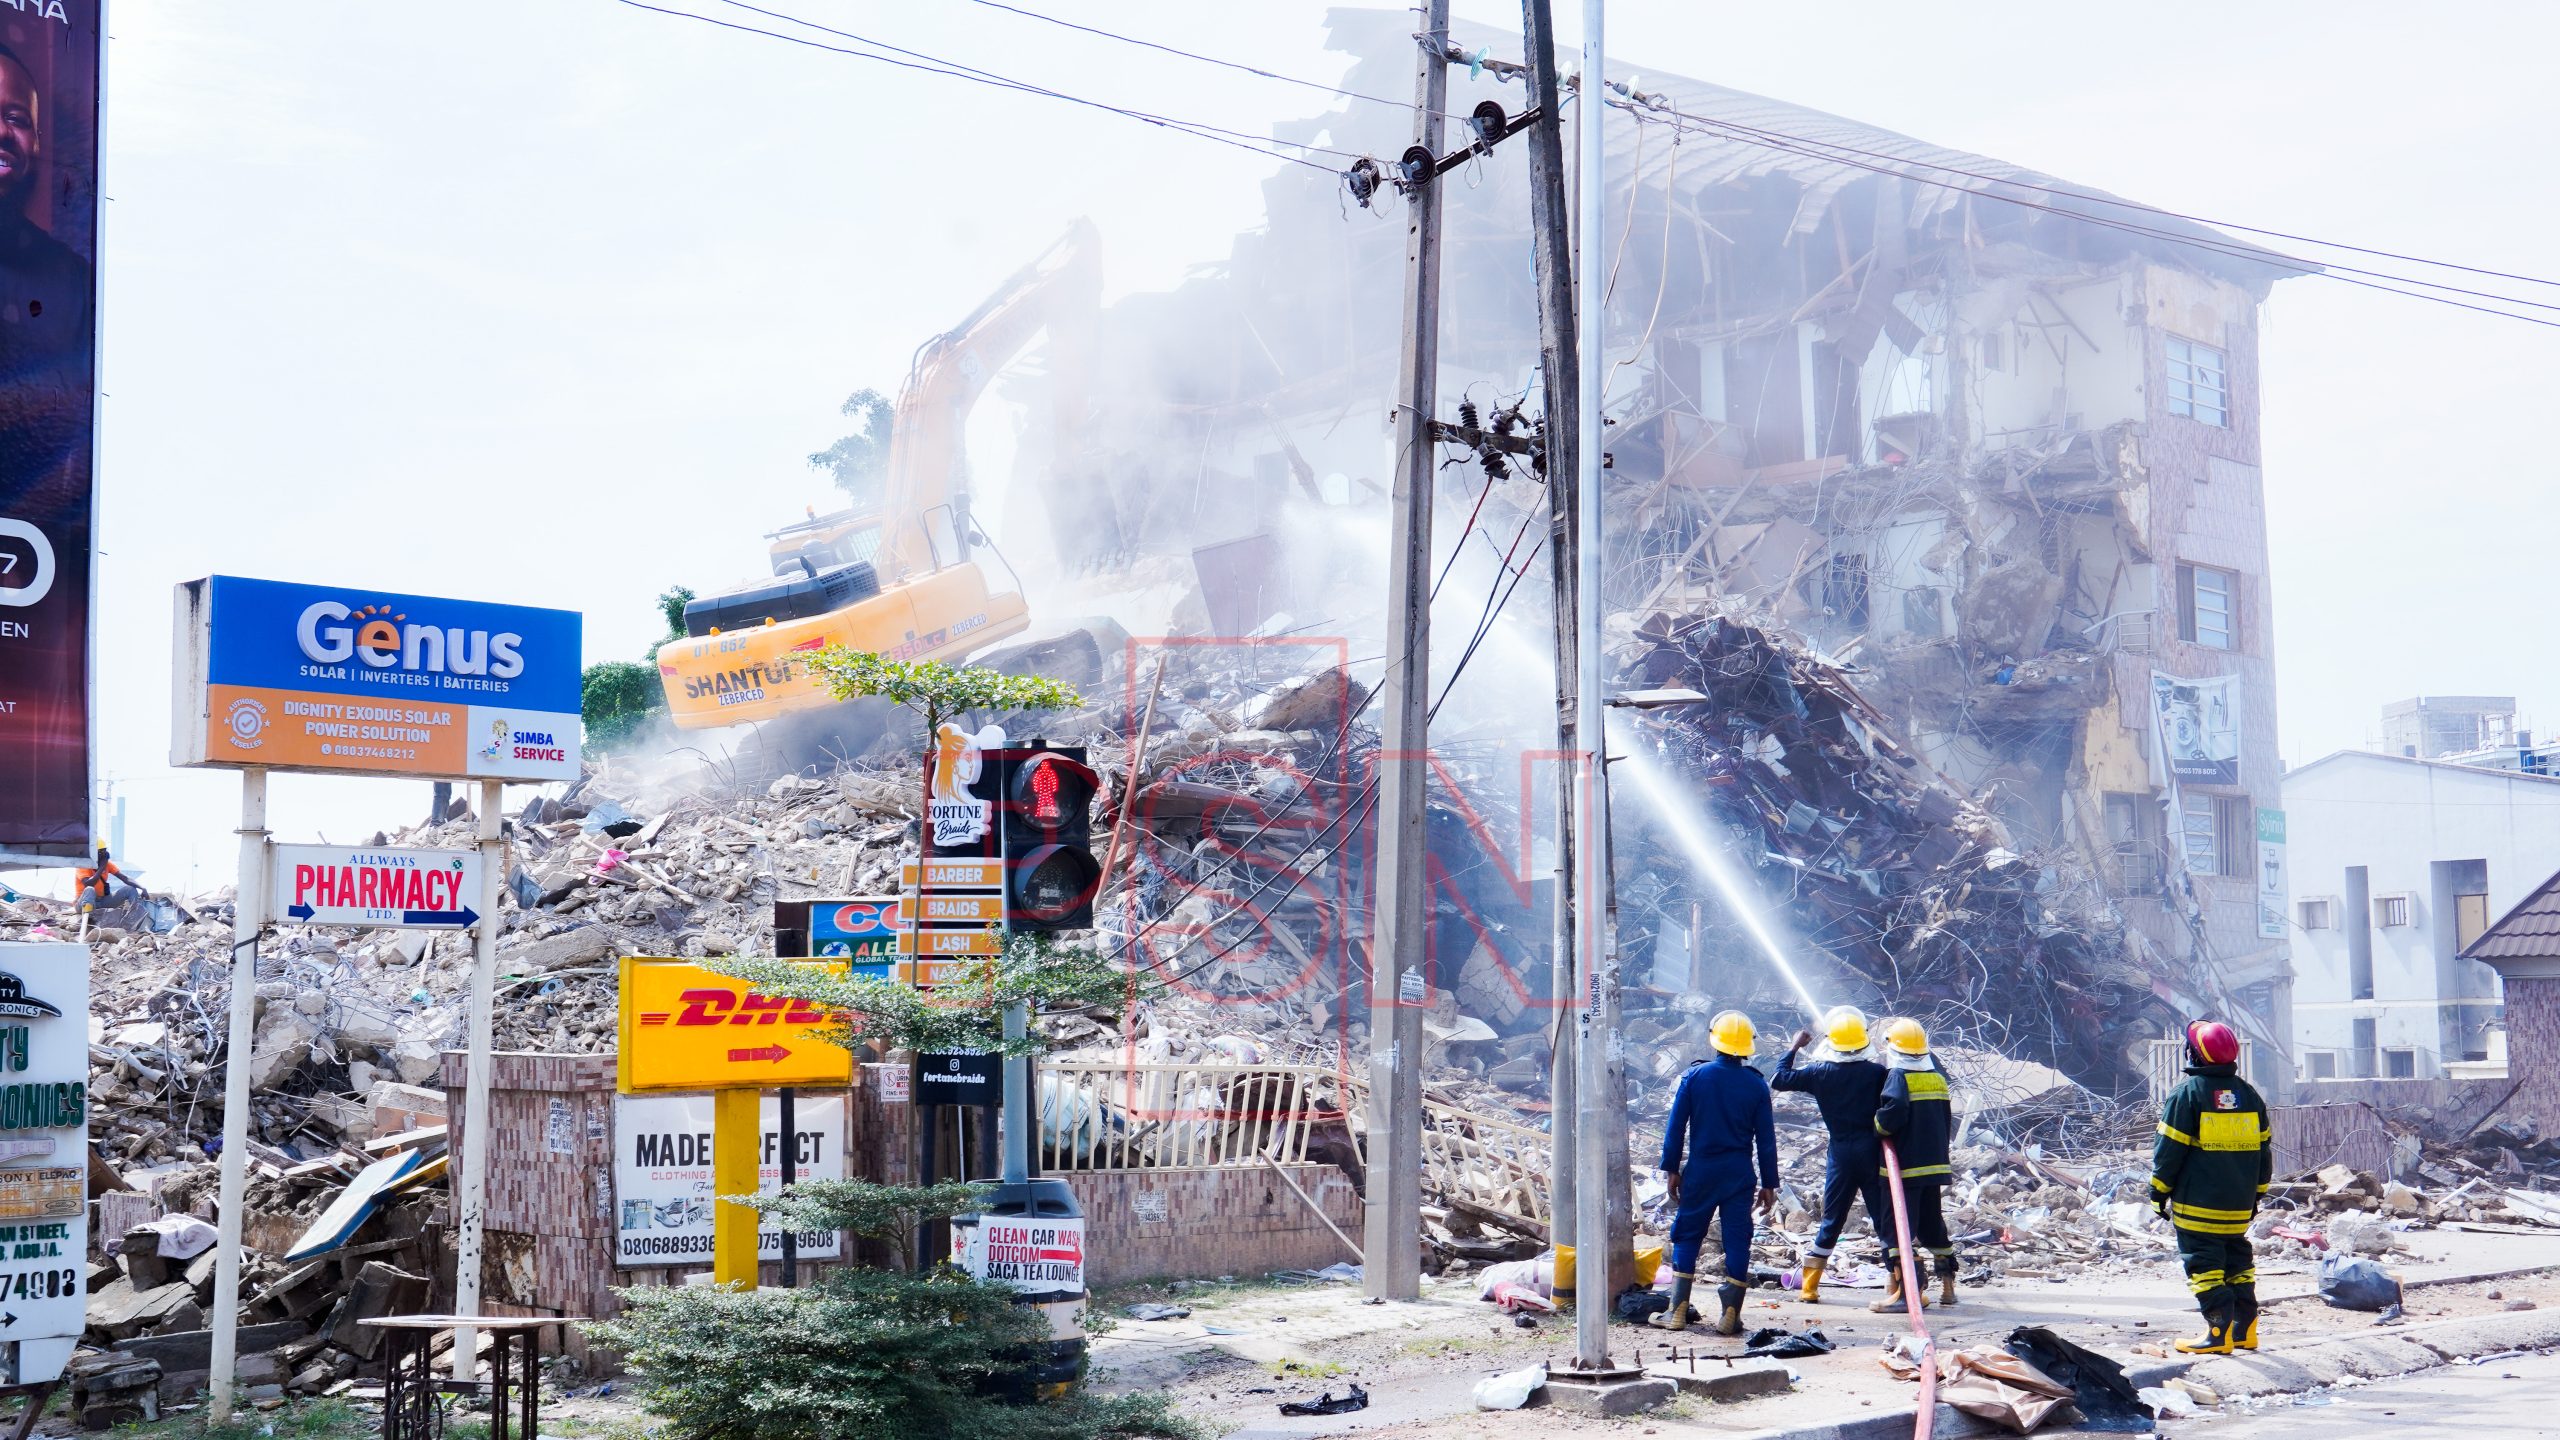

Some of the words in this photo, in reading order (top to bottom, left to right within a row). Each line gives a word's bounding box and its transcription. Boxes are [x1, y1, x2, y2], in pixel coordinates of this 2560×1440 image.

[951, 613, 988, 637] ZEBERCED
[296, 600, 524, 679] Genus
[300, 664, 347, 680] SOLAR
[360, 669, 430, 686] INVERTERS
[443, 676, 510, 693] BATTERIES
[718, 688, 765, 706] ZEBERCED
[284, 700, 344, 720] DIGNITY
[346, 706, 403, 723] EXODUS
[404, 710, 452, 726] SOLAR
[305, 721, 358, 740] POWER
[361, 725, 431, 744] SOLUTION
[513, 731, 554, 746] SIMBA
[229, 736, 264, 750] RESELLER
[334, 744, 415, 761] 08037468212
[513, 746, 565, 762] SERVICE
[928, 805, 982, 819] FORTUNE
[937, 819, 980, 841] Braids
[349, 854, 416, 867] ALLWAYS
[927, 867, 984, 883] BARBER
[295, 864, 464, 911] PHARMACY
[366, 909, 396, 920] LTD.
[927, 901, 980, 916] BRAIDS
[933, 936, 970, 951] LASH
[855, 956, 886, 964] GLOBAL
[675, 988, 826, 1026] DHL
[0, 1082, 86, 1130] ONICS
[651, 1170, 707, 1181] CLOTHING
[19, 1223, 70, 1241] STREET,
[989, 1226, 1029, 1245] CLEAN
[1031, 1229, 1055, 1246] CAR
[13, 1242, 63, 1260] ABUJA.
[988, 1245, 1040, 1263] DOTCOM
[987, 1262, 1020, 1280] SACA
[1023, 1263, 1043, 1281] TEA
[1046, 1264, 1080, 1283] LOUNGE
